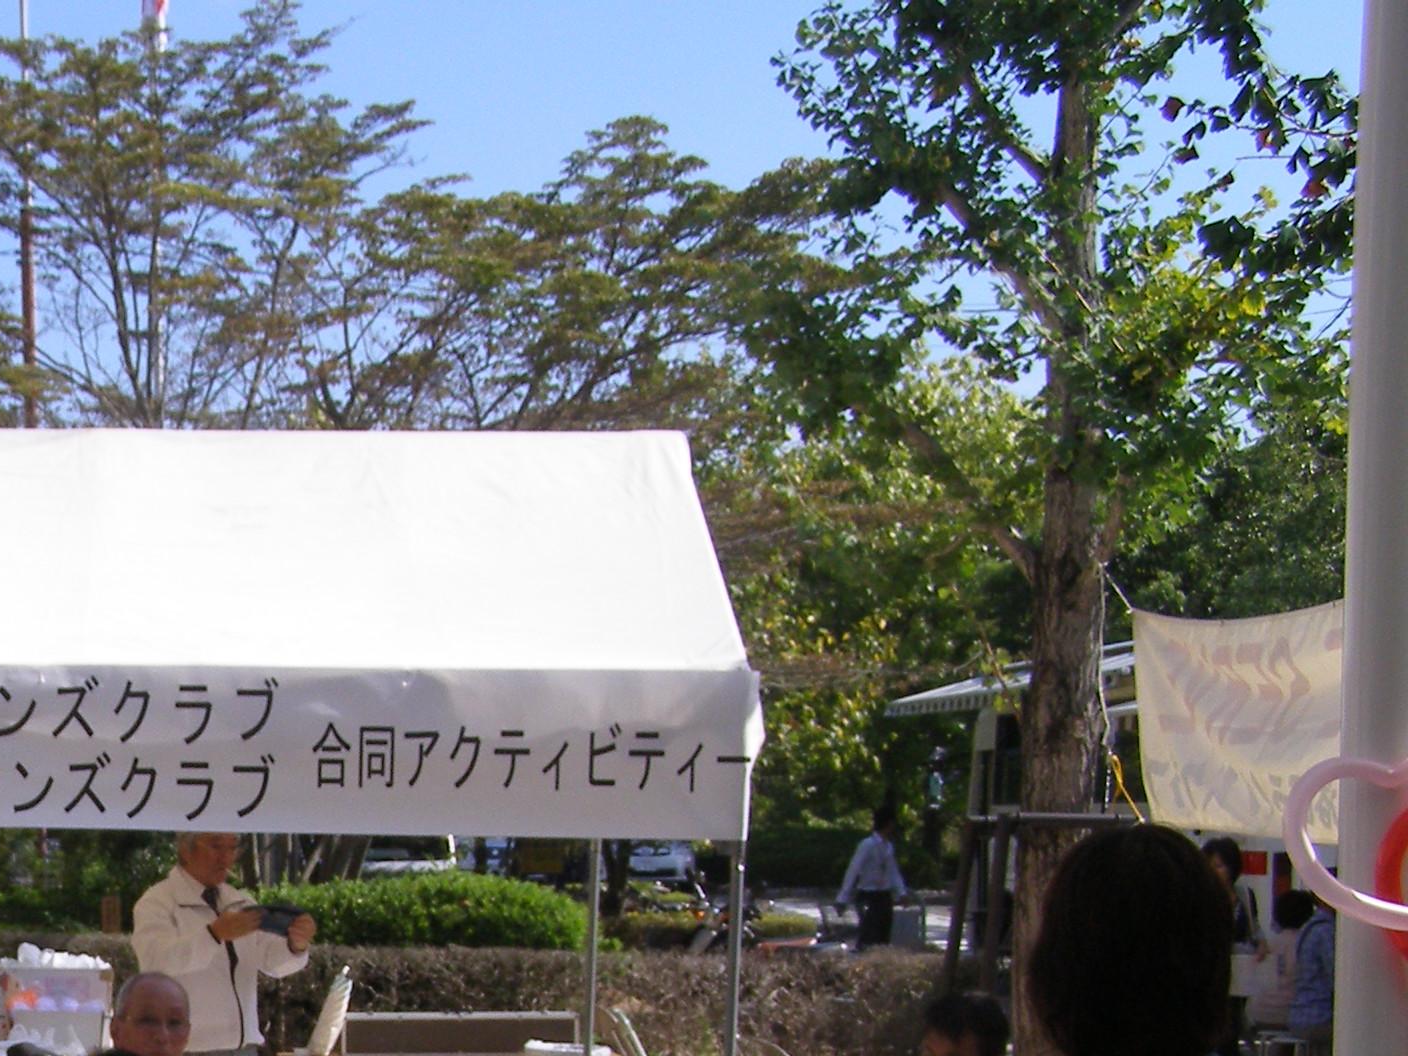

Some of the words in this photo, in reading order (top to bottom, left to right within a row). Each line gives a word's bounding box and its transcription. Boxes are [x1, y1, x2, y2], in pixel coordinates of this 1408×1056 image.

[312, 722, 750, 793] 合同アクティビティー
